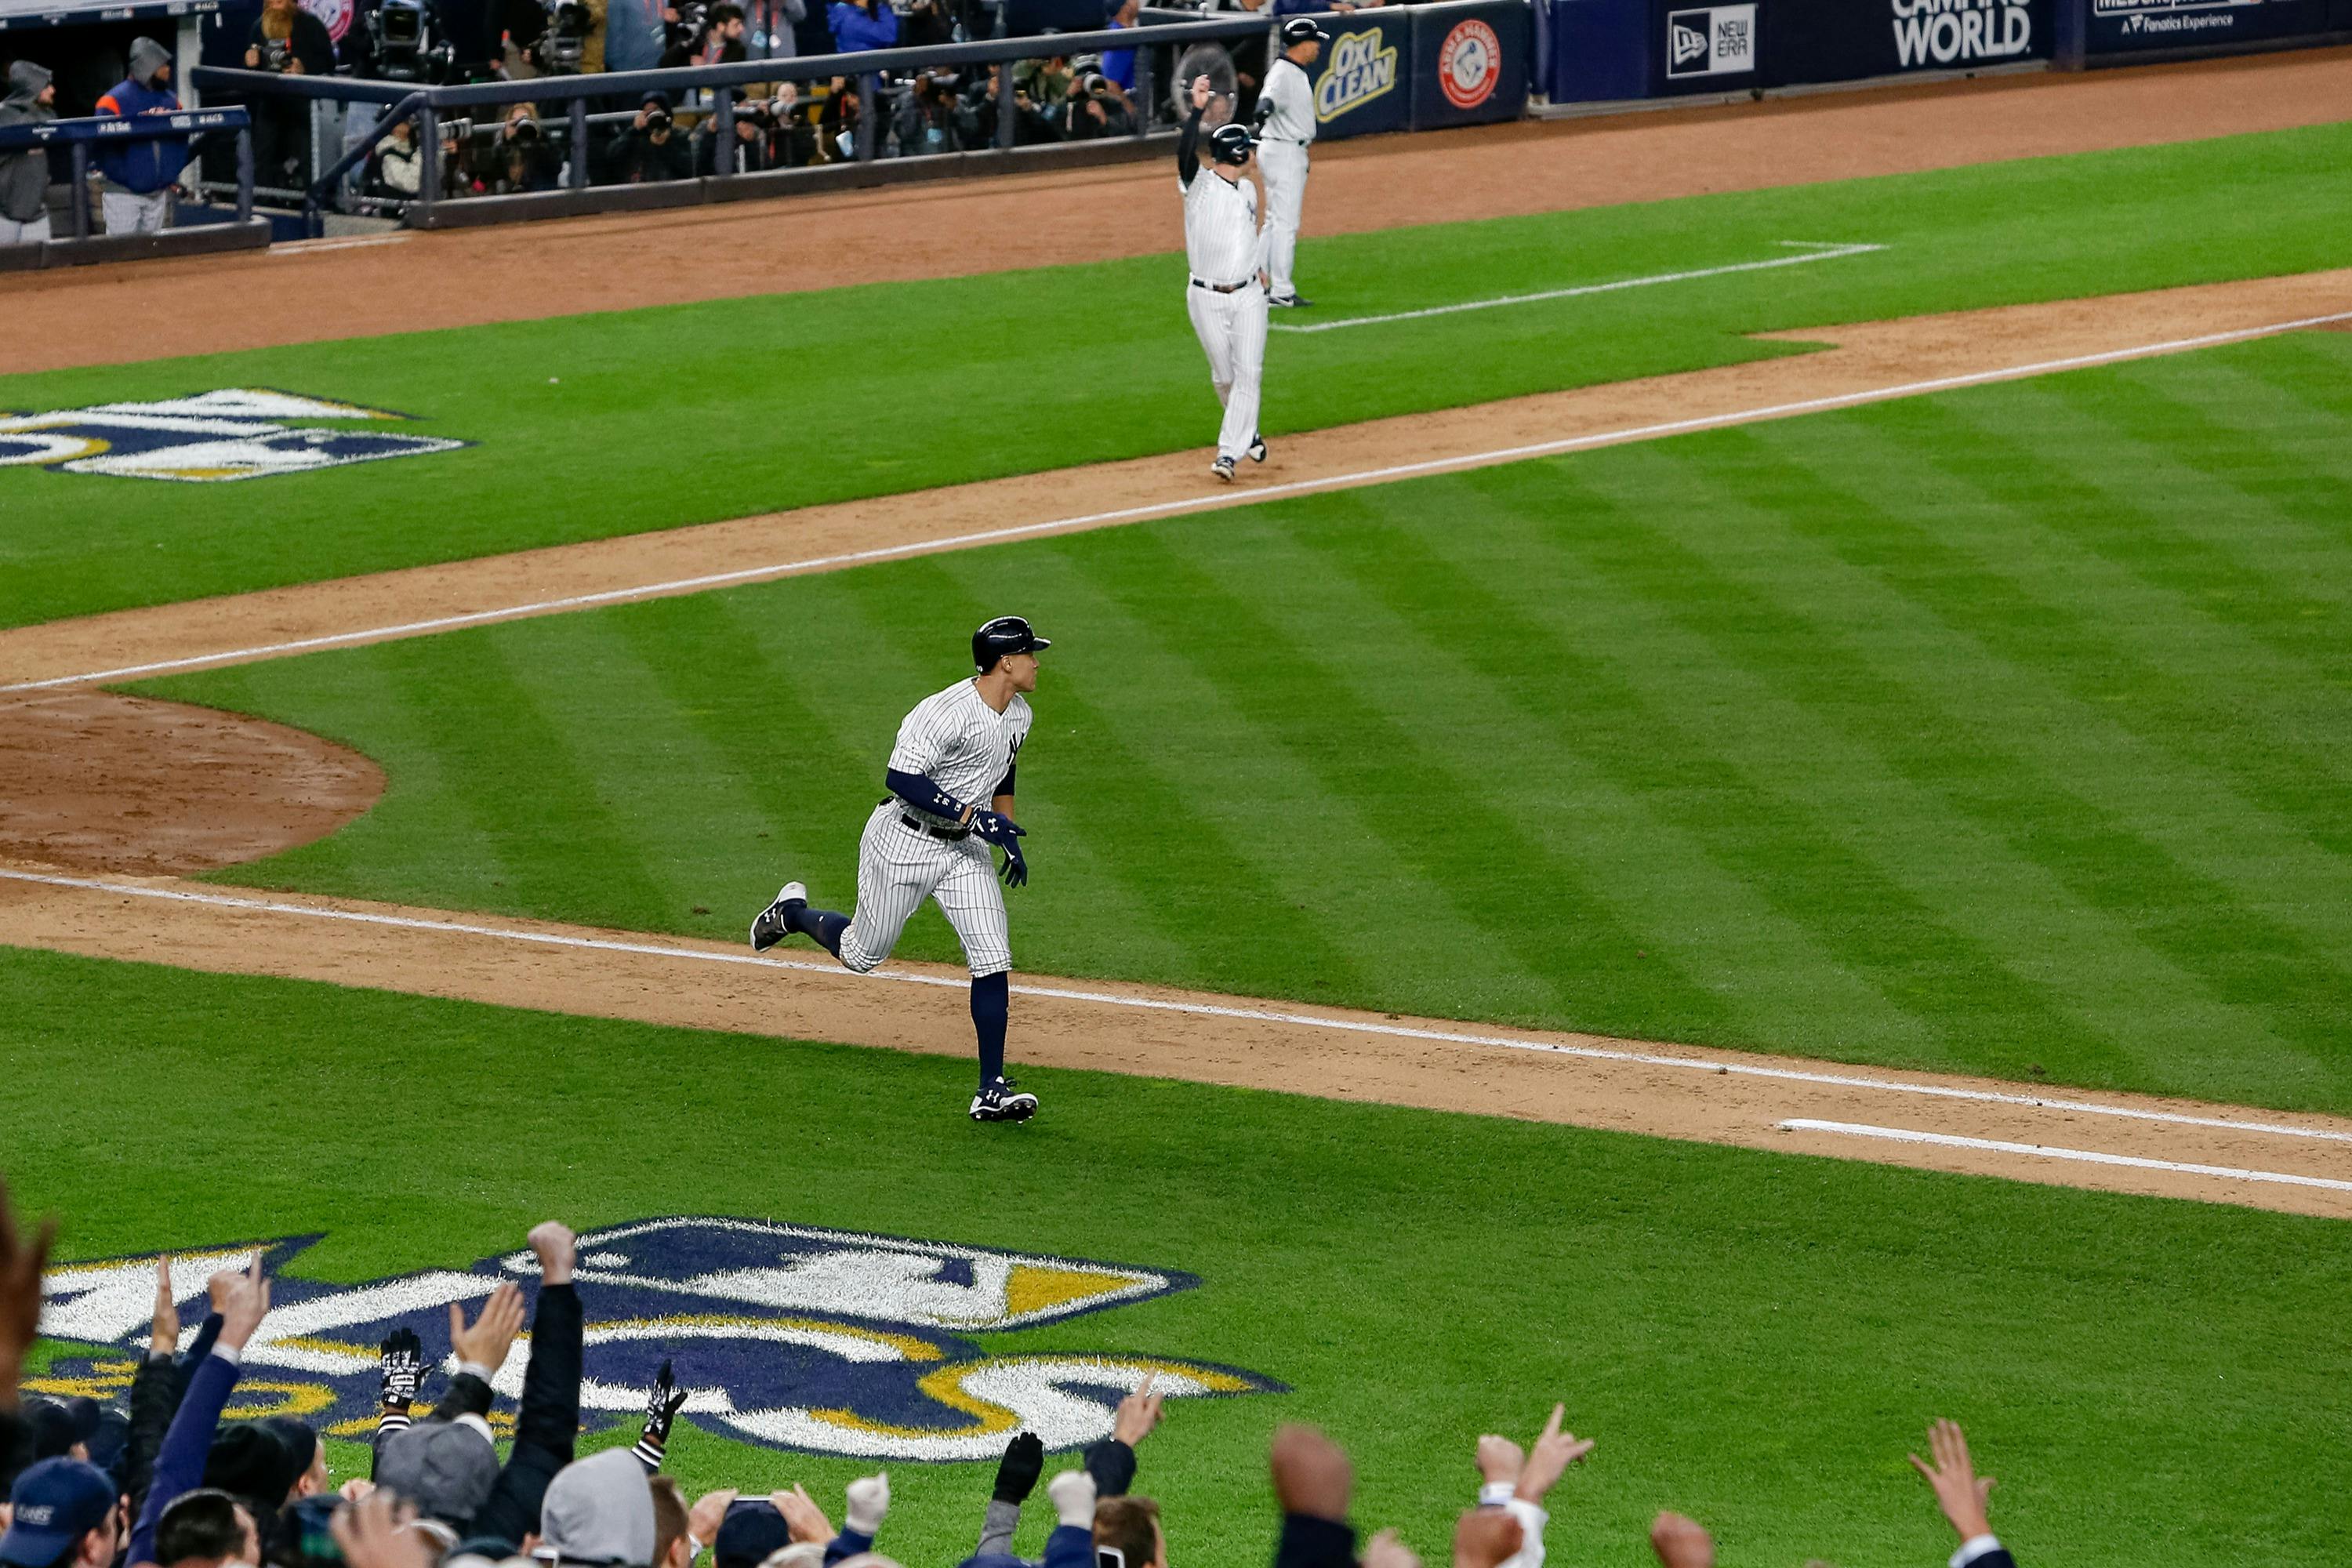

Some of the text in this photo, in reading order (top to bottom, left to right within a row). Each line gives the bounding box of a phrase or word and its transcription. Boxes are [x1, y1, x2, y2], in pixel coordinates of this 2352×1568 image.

[1718, 20, 1748, 38] NEW
[1893, 5, 2031, 67] WORLD
[2143, 15, 2182, 33] Fanatics
[2183, 14, 2234, 31] Experience
[1335, 34, 1377, 77] OXI
[1718, 38, 1748, 56] ERA
[1319, 55, 1392, 115] CLEAN
